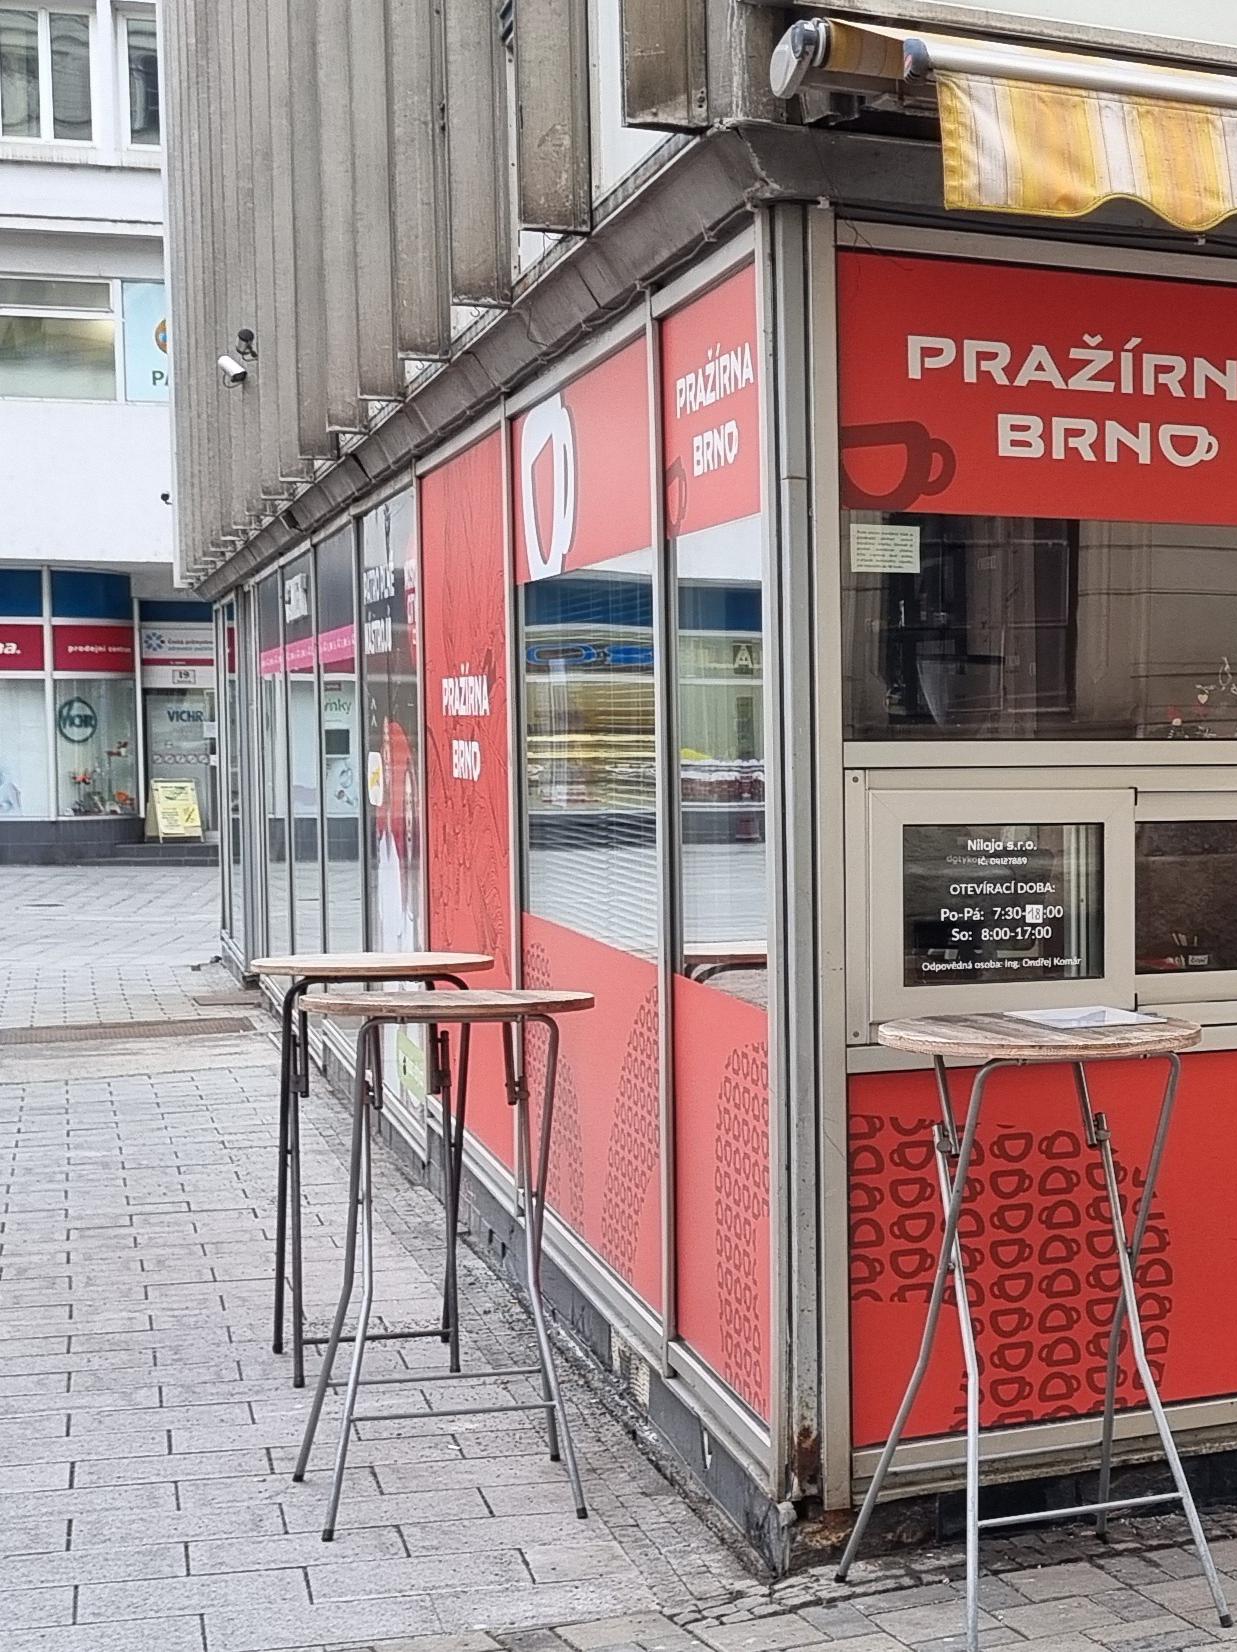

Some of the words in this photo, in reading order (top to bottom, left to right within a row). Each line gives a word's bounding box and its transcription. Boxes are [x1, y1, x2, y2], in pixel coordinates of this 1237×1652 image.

[676, 342, 754, 419] PRAŽÍRNA
[693, 420, 739, 477] BRNO
[997, 413, 1219, 467] BRNO
[442, 661, 490, 716] PRAŽÍRNA
[167, 710, 204, 723] VICHR
[452, 739, 481, 781] BRNO
[1006, 841, 1037, 850] s.r.o.
[950, 880, 1015, 895] OTEVÍRACÍ
[1017, 882, 1055, 894] DOBA:
[940, 907, 984, 922] Po-Pá:
[993, 905, 1063, 922] 7:30-18:00
[951, 928, 972, 941] So:
[981, 926, 1052, 941] 8:00-17:00
[922, 960, 972, 972] Odpovědná
